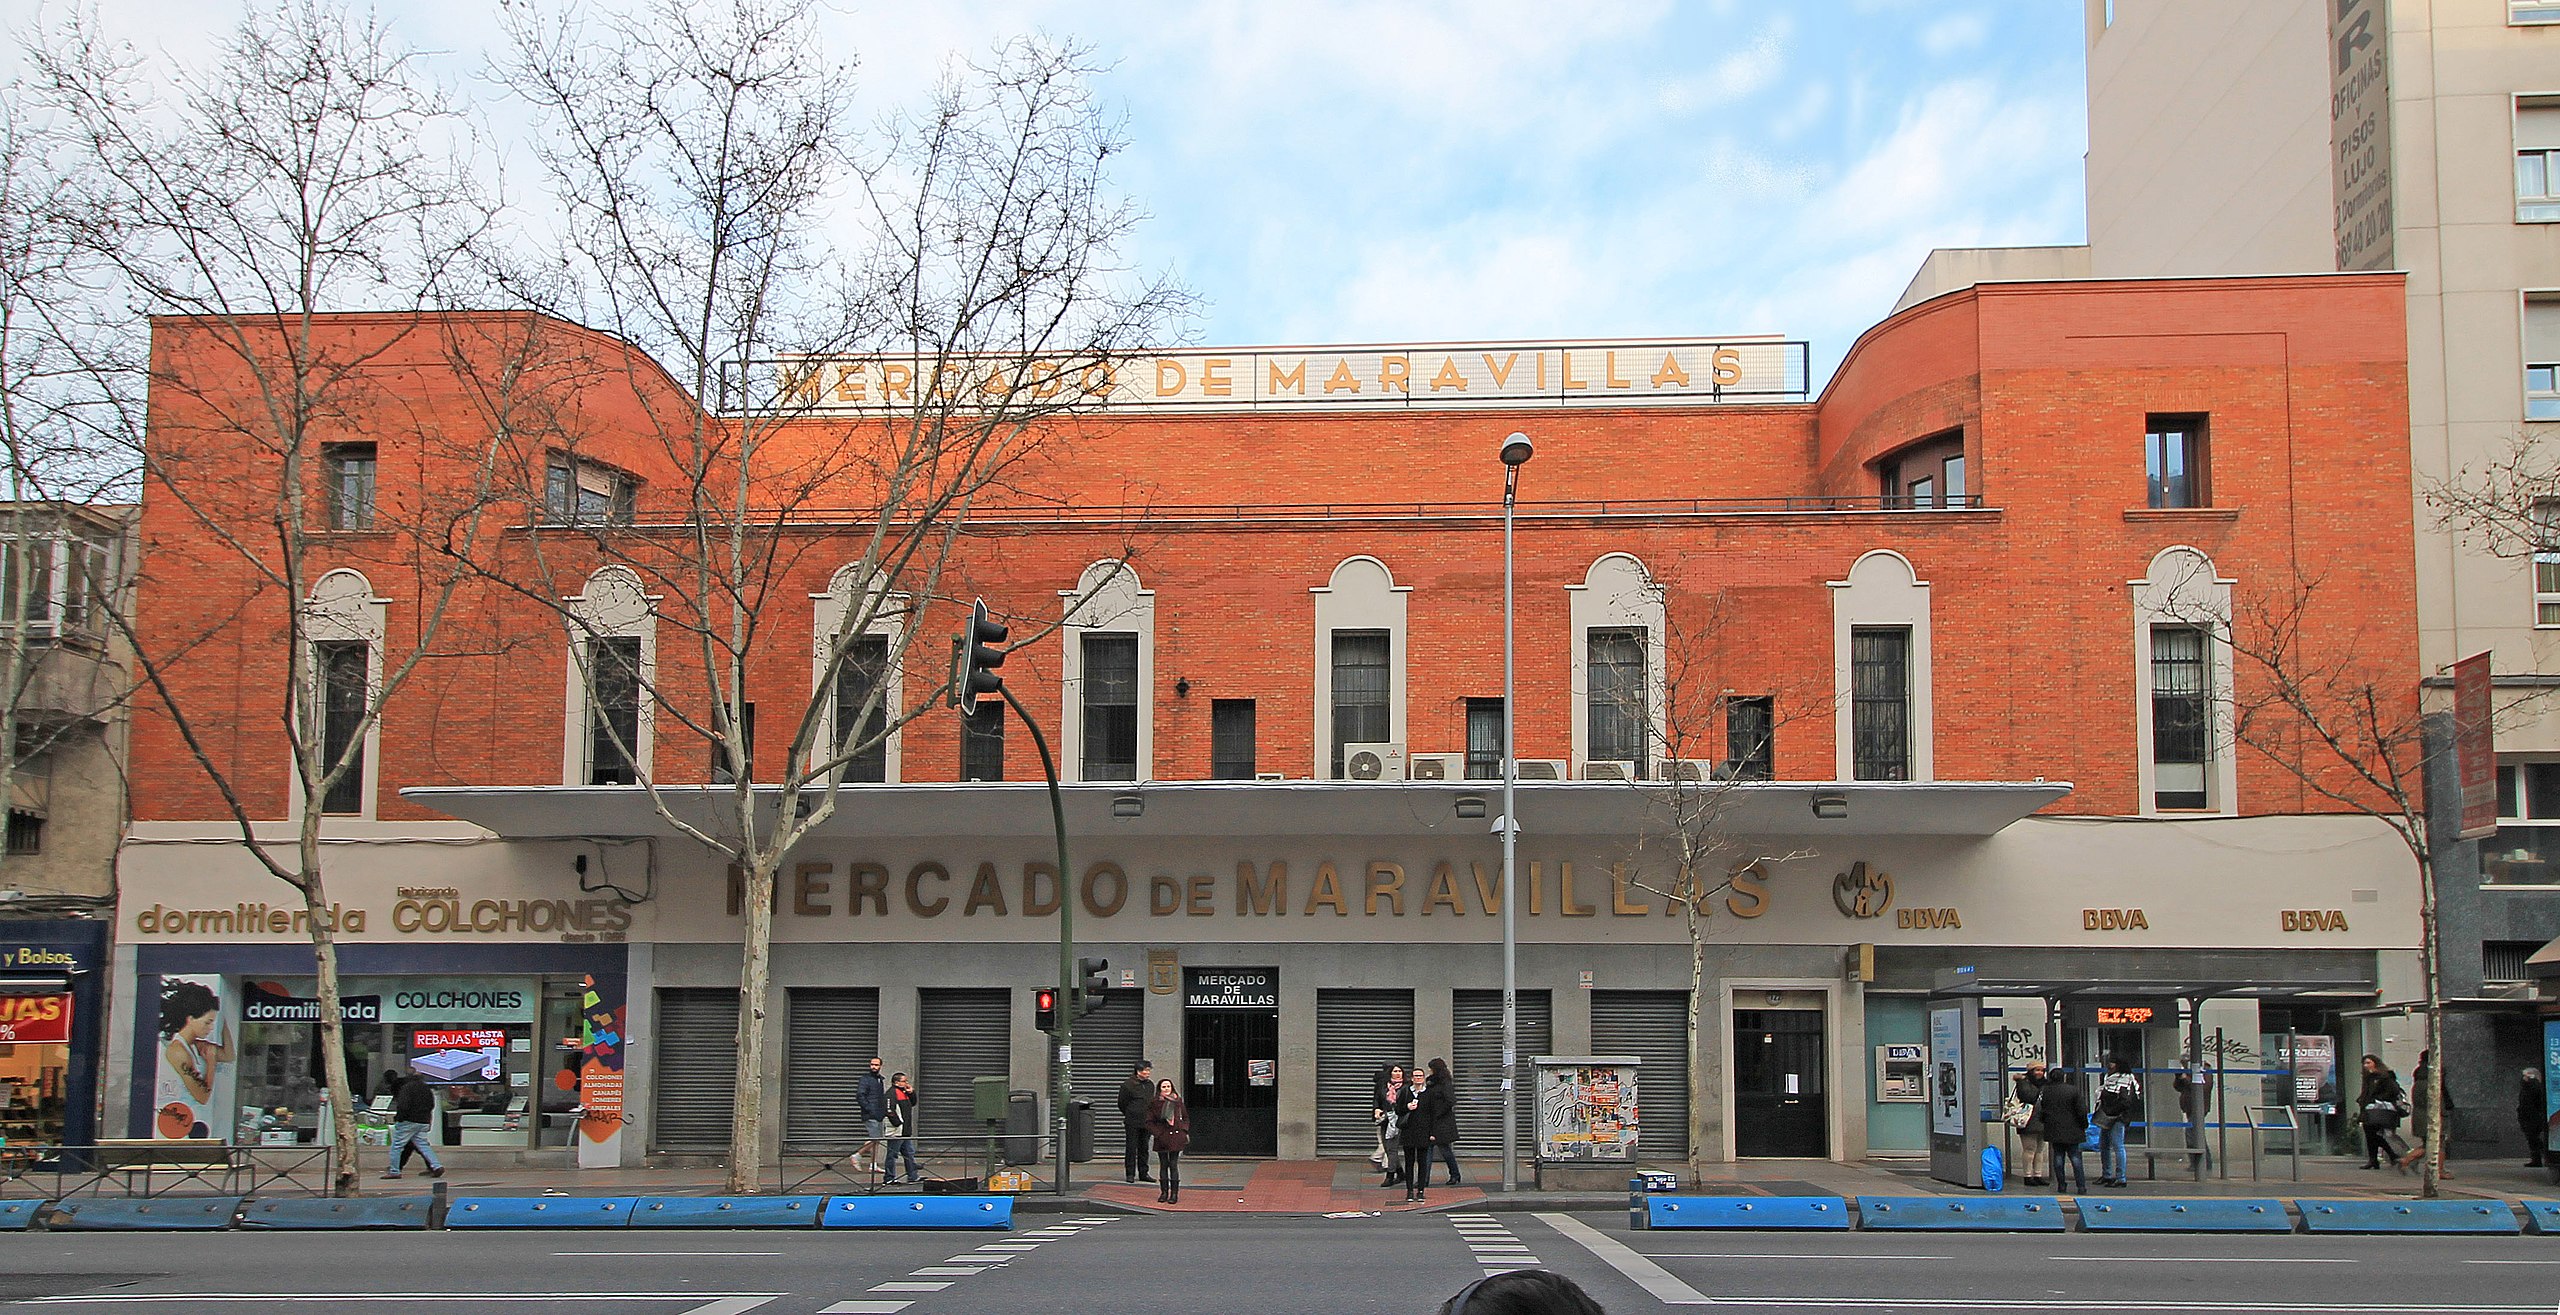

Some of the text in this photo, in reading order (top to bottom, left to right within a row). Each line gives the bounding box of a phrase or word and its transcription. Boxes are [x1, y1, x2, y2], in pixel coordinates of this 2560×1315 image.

[2332, 49, 2381, 122] OFICINAS
[2340, 111, 2375, 163] PISOS
[2344, 145, 2375, 191] LUJO
[779, 349, 1742, 402] MERCADO DE MARAVILLAS
[1150, 876, 1216, 918] DE
[1235, 860, 1771, 919] MARAVILLAS
[392, 899, 632, 933] COLCHONES
[1897, 908, 1961, 930] BBVA
[2083, 908, 2149, 931] BBVA
[2281, 909, 2349, 932] BBVA
[4, 947, 73, 967] y Bolsos
[1198, 975, 1266, 986] MERCADO
[1224, 985, 1241, 995] DE
[247, 991, 523, 1019] dormitinda COLCHONES
[1189, 994, 1275, 1005] MARAVILLAS
[417, 1033, 472, 1045] REBAJAS
[472, 1030, 504, 1038] HASTA
